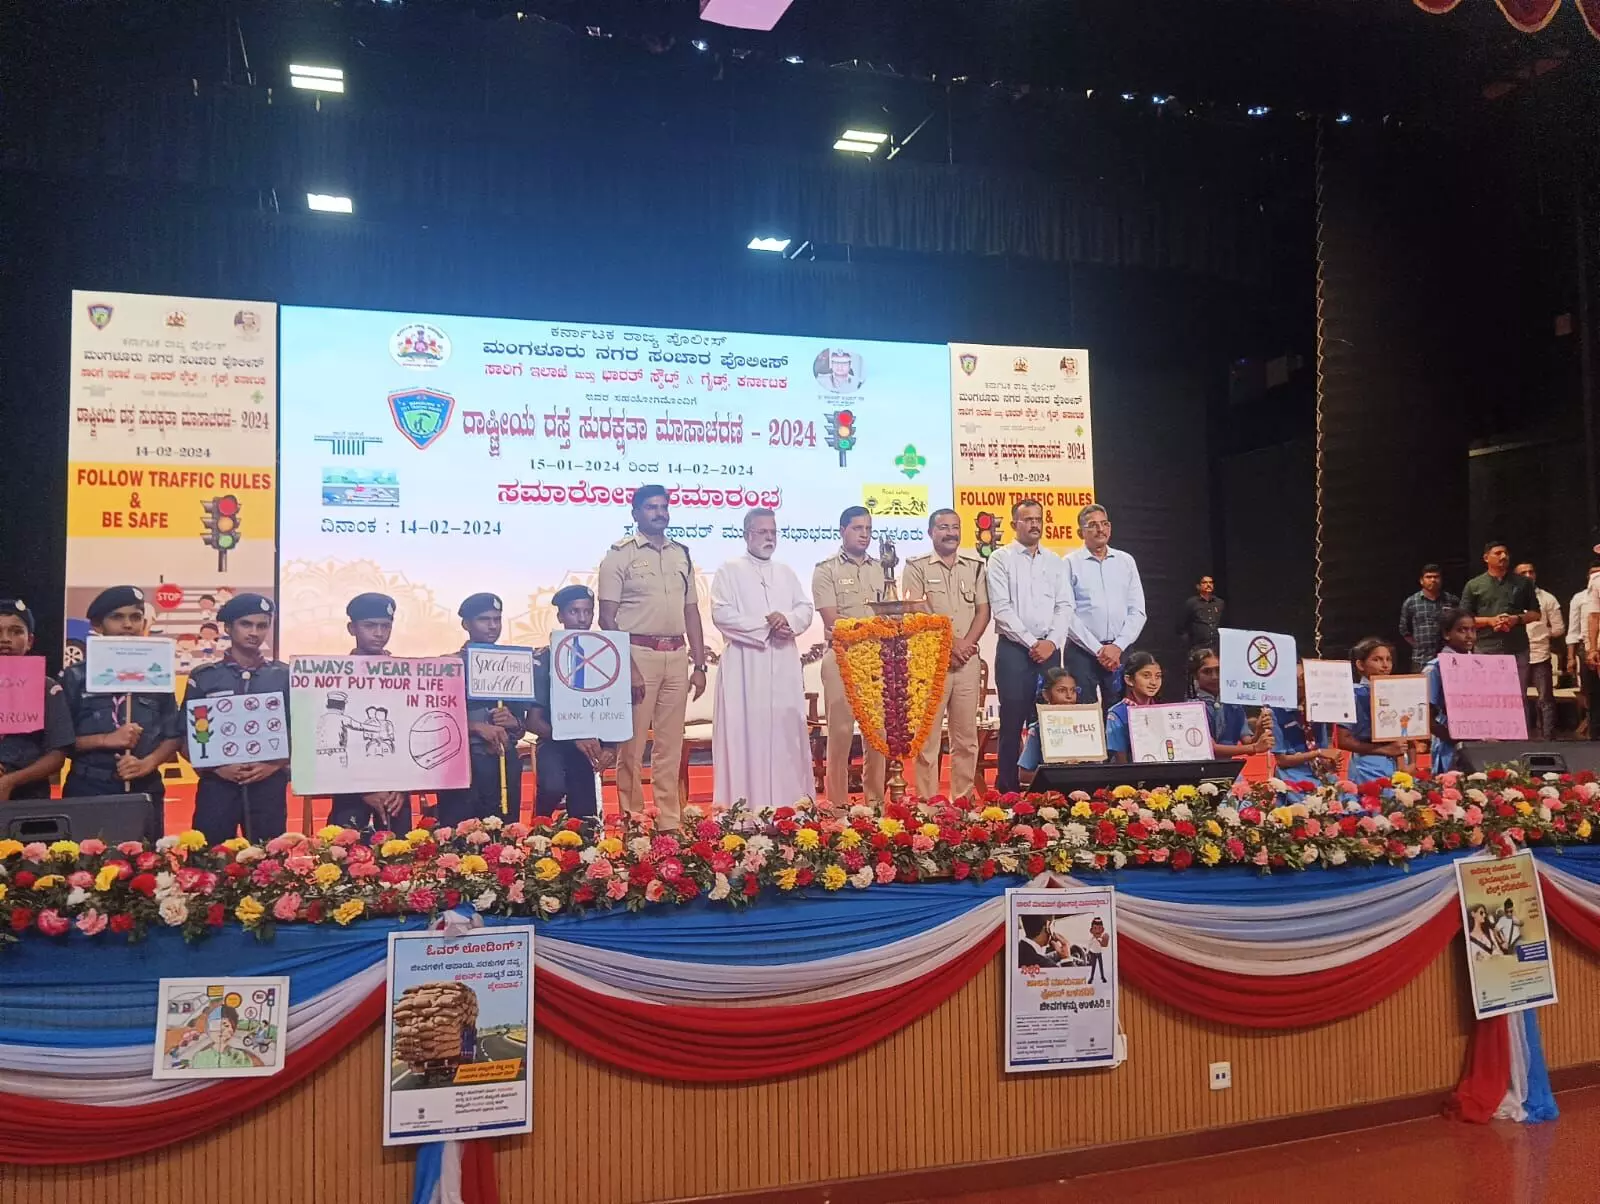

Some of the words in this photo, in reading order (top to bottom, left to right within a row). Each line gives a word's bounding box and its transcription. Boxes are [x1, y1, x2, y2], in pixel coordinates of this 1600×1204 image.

[551, 327, 615, 343] ಕರ್ನಾಟಕ
[483, 340, 586, 359] ಮಂಗಳೂರು
[596, 347, 638, 361] ನಗರ
[648, 349, 711, 365] ಸಂಚಾರ
[721, 352, 789, 370] ಪೊಲೀಸ್
[485, 363, 523, 376] ಸಾರಿಗೆ
[529, 364, 568, 378] ಇಲಾಖೆ
[602, 369, 643, 383] ಭಾರತ್
[737, 376, 788, 389] ಕರ್ನಾಟಕ
[242, 411, 270, 430] 2024
[463, 404, 536, 458] ರಾಷ್ಟ್ರೀಯ
[544, 405, 571, 451] ರಸ್ತೆ
[579, 406, 648, 455] ಸುರಕ್ಷತಾ
[656, 409, 743, 444] ಮಾಸಾಚರಣೆ
[769, 418, 816, 447] 2024
[136, 446, 211, 458] 14-02-2024
[1067, 443, 1086, 460] 2024
[530, 459, 620, 472] 15-01-2024
[667, 463, 754, 476] 14-02-2024
[77, 469, 144, 487] FOLLOW
[149, 471, 215, 489] TRAFFIC
[220, 473, 272, 490] RULES
[999, 473, 1050, 482] 14-02-2024
[130, 492, 141, 509] &
[961, 491, 1006, 506] FOLLOW
[1057, 493, 1092, 507] RULES
[103, 512, 123, 528] BE
[128, 512, 169, 528] SAFE
[1046, 510, 1053, 523] &
[321, 517, 376, 534] ದಿನಾಂಕ
[400, 519, 502, 535] 14-02-2024
[1046, 526, 1072, 540] SAFE
[157, 591, 181, 600] STOP
[293, 659, 354, 675] ALWAYS
[366, 661, 412, 677] WEAR
[417, 663, 463, 677] HELMET
[291, 676, 309, 688] DO
[315, 676, 342, 689] NOT
[348, 677, 374, 690] PUT
[379, 677, 411, 691] YOUR
[418, 678, 444, 691] LIFE
[1226, 679, 1238, 688] NO
[1243, 681, 1267, 690] MOBILE
[406, 694, 419, 708] IN
[426, 694, 457, 708] RISK
[600, 711, 625, 721] DRIVE
[1072, 723, 1096, 734] KILLS
[426, 944, 459, 956] ಓವರ್
[462, 940, 515, 954] ಲೋಡಿಂಗ್
